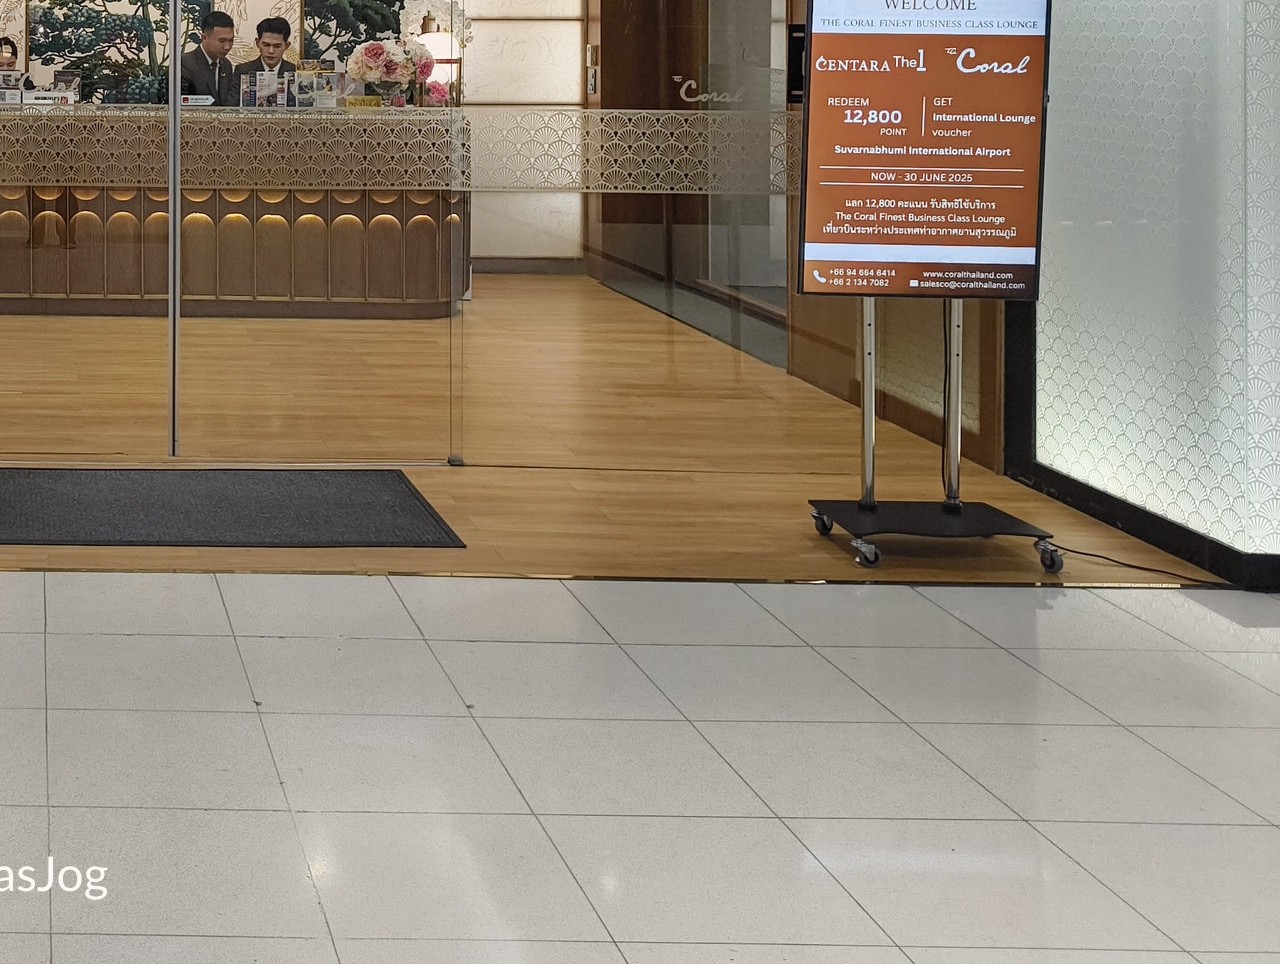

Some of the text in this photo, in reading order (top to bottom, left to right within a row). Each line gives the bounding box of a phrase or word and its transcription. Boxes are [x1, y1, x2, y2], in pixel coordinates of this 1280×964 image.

[821, 18, 1038, 29] THE CORAL FINEST BUSINESS CLASS LOUNGE
[815, 55, 891, 72] CENTARA
[956, 47, 1030, 74] Coral
[679, 80, 744, 102] Coral
[828, 97, 869, 106] REDEEM
[933, 97, 953, 106] GET
[843, 109, 902, 126] 12,800
[932, 112, 1036, 124] International Lounge
[880, 127, 907, 135] POINT
[932, 127, 972, 137] voucher
[834, 145, 1011, 158] Suvarnabhumi International Airport
[871, 172, 897, 181] NOW
[904, 173, 917, 181] 30
[919, 173, 946, 182] JUNE
[948, 174, 973, 182] 2025
[866, 199, 896, 209] 12,800
[835, 212, 1005, 225] The Coral Finest Business Class Lounge
[828, 268, 844, 276] +66
[859, 269, 874, 277] 664
[876, 269, 896, 277] 6414
[922, 270, 1013, 279] www.coralthailand.com
[869, 279, 889, 287] 7082
[919, 280, 1026, 290] salesco@coralthailand.com
